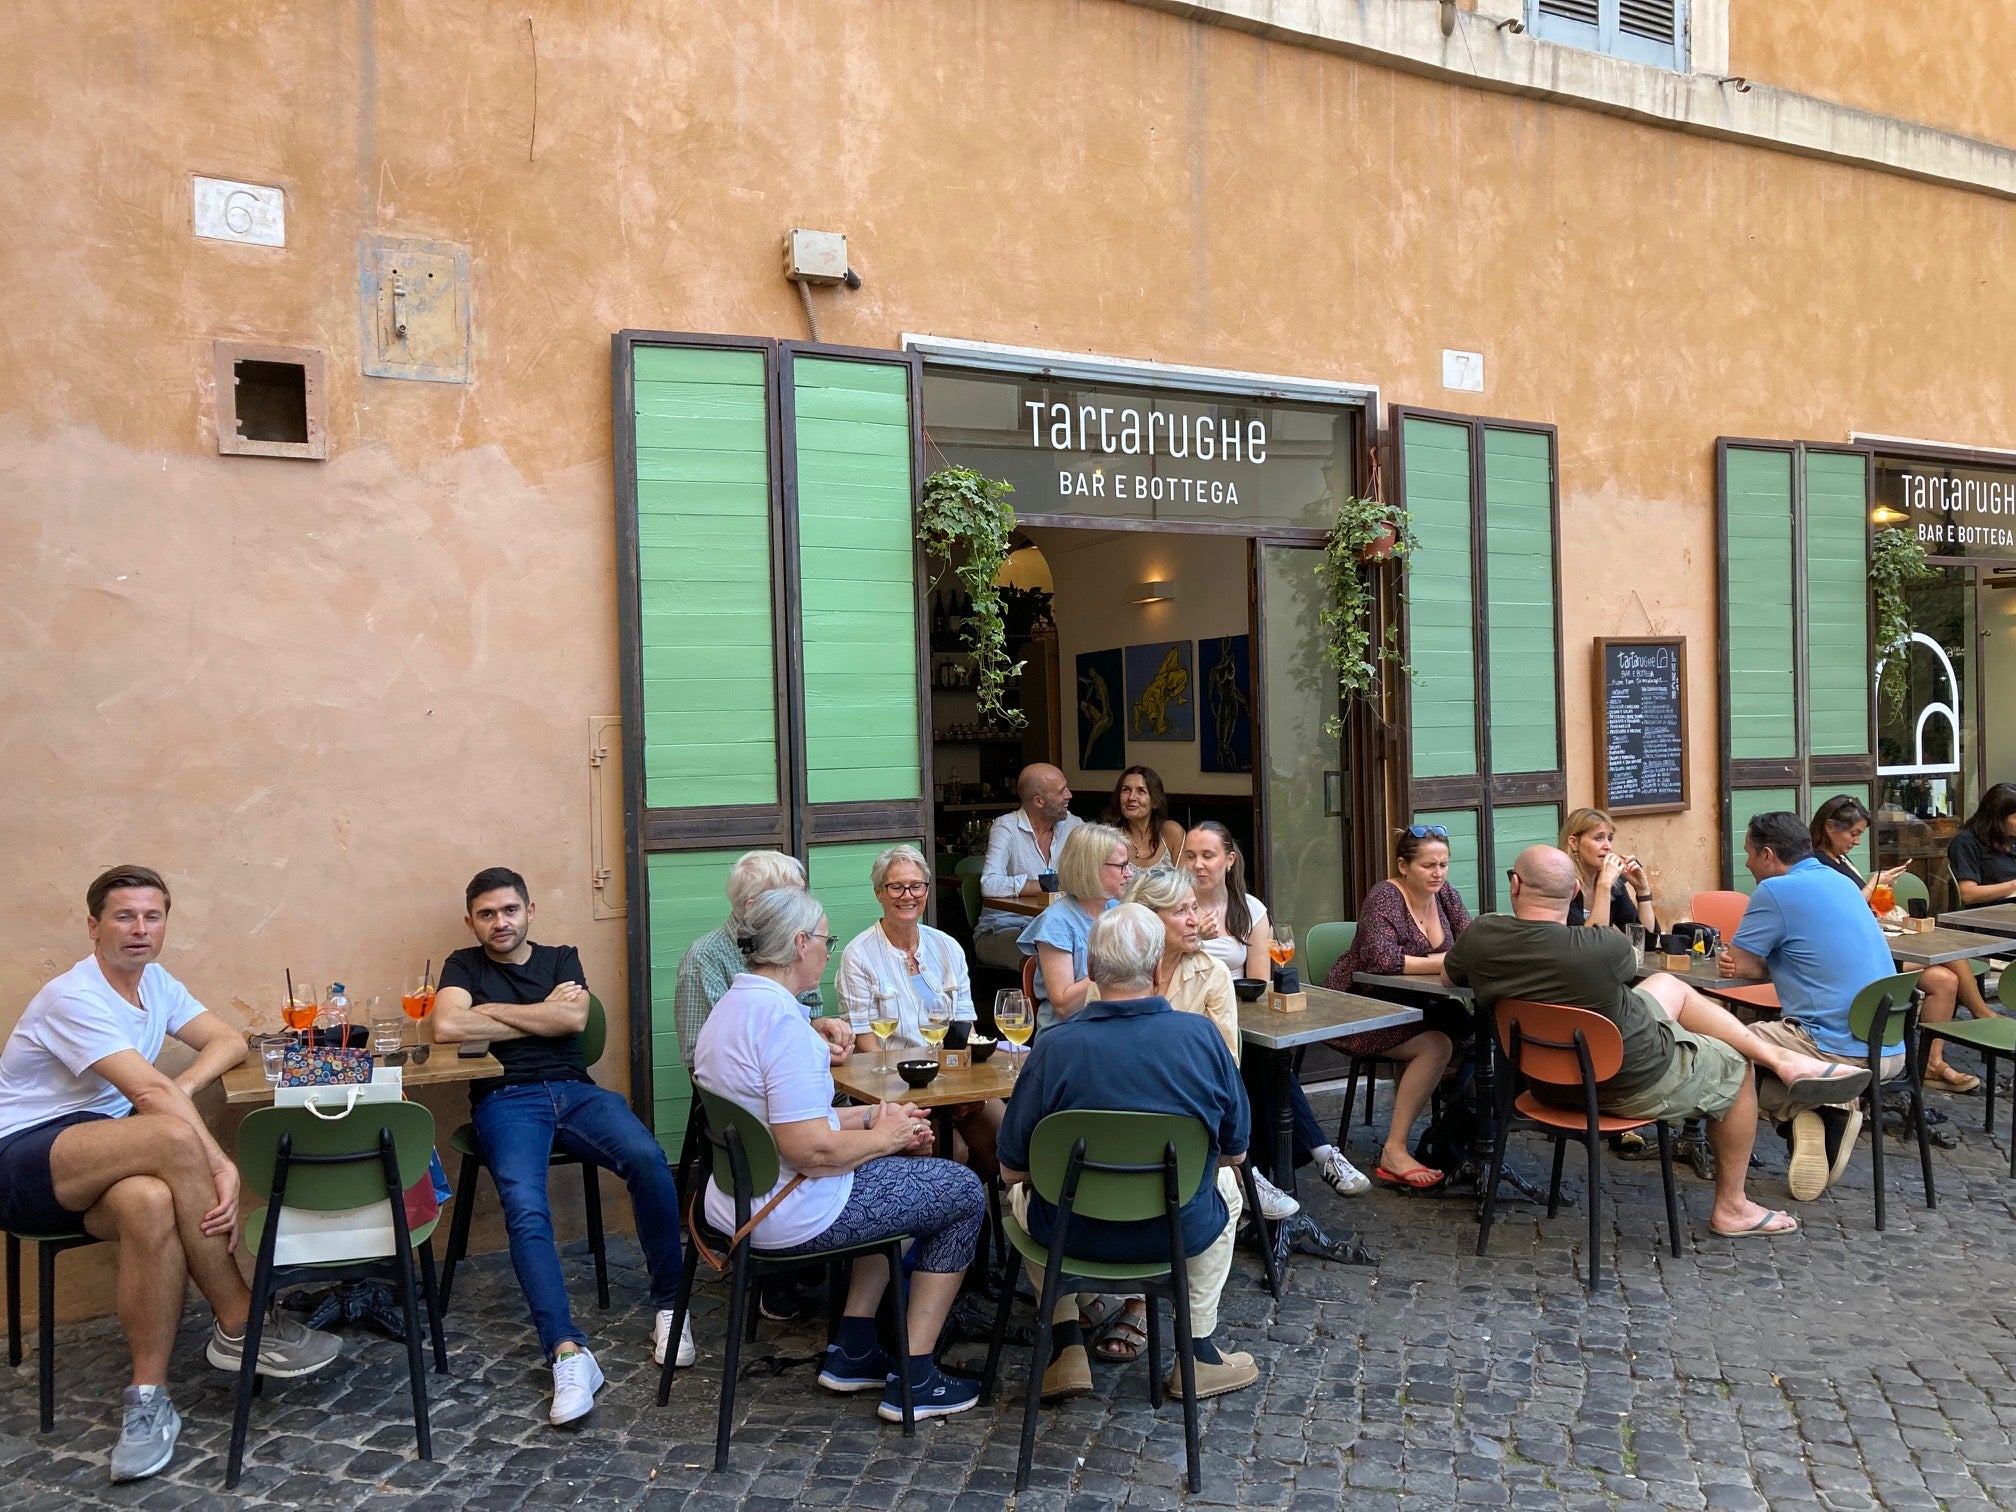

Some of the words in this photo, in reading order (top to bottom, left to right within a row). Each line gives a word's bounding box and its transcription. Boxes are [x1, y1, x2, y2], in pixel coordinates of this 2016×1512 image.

[224, 190, 260, 234] 6
[1456, 355, 1470, 387] 7
[1060, 471, 1106, 497] BAR
[1115, 474, 1128, 499] E
[1135, 475, 1239, 505] BOTTEGA
[1918, 523, 1943, 542] BAR
[1947, 525, 1955, 542] E
[1958, 526, 2014, 546] BOTTEGA
